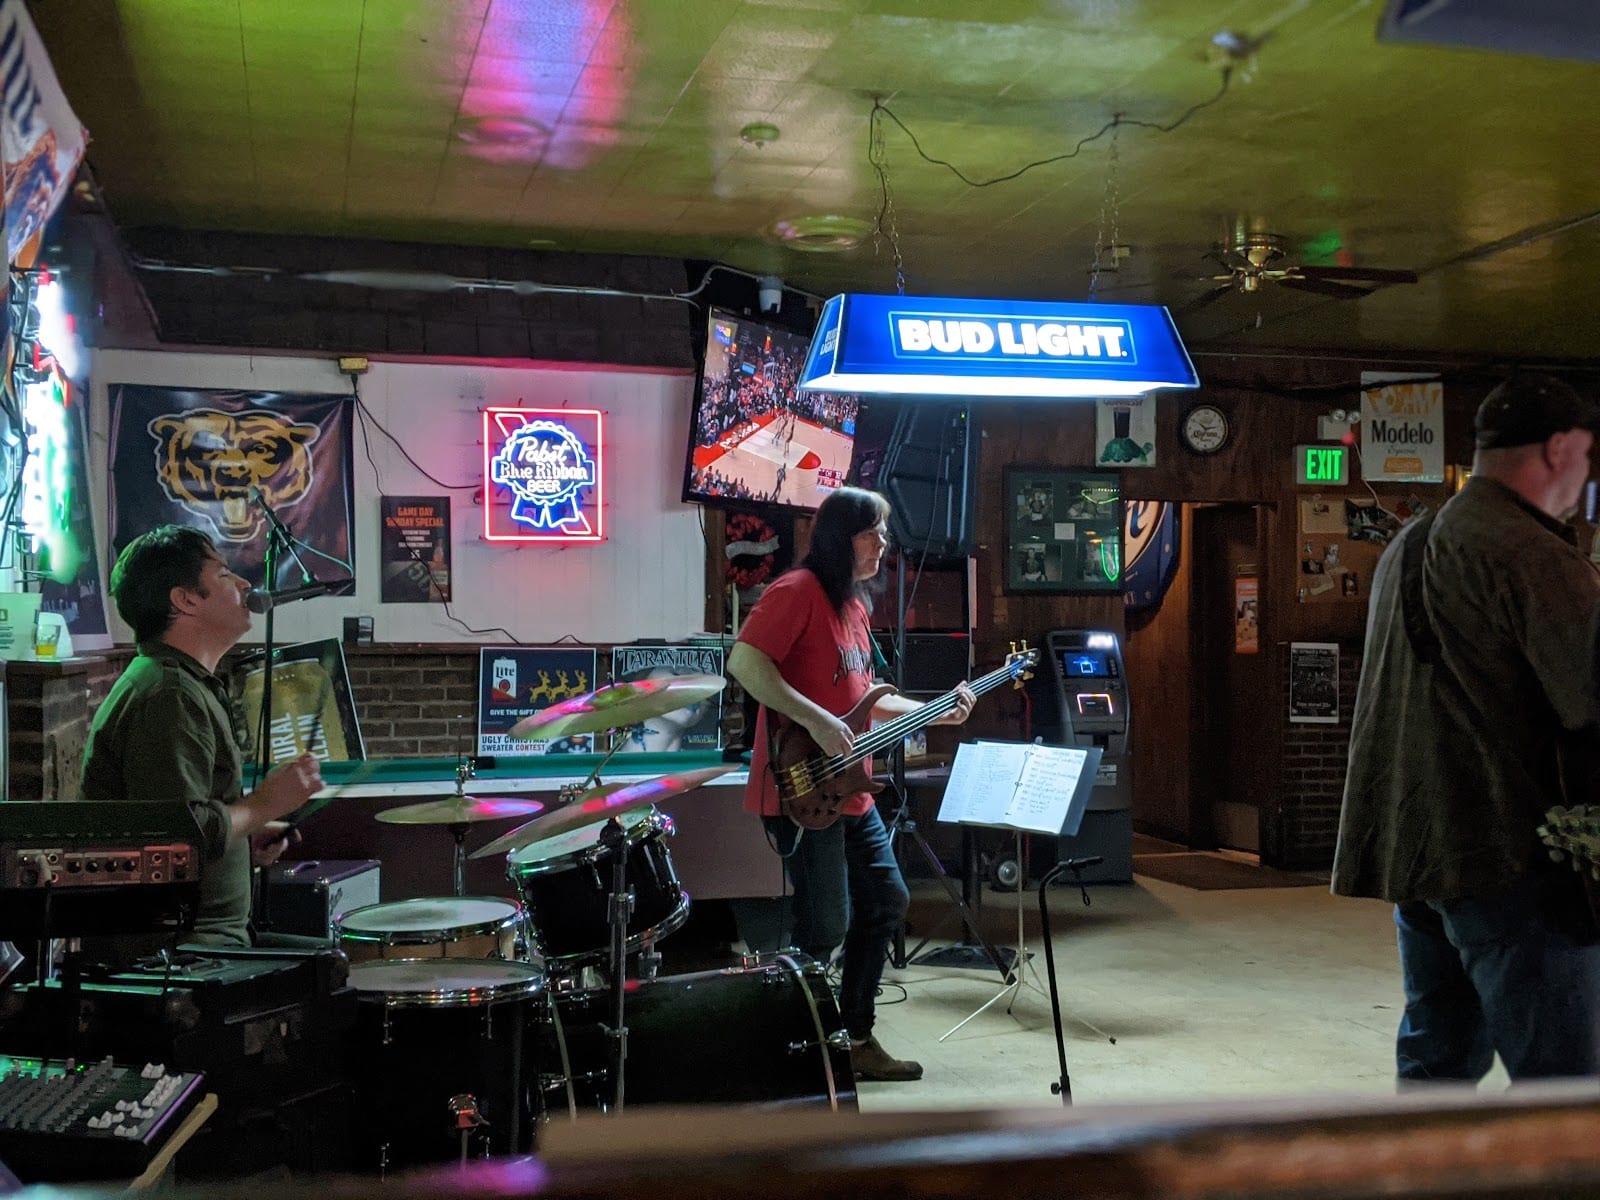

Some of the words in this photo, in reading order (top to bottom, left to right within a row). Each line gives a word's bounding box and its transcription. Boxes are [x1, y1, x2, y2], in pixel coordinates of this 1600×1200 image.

[899, 319, 995, 353] BUD
[1371, 420, 1434, 445] Modelo
[514, 436, 571, 463] Pabst
[500, 461, 533, 479] Blue
[535, 461, 588, 480] Ribbon
[1306, 449, 1342, 480] EXIT
[527, 480, 561, 492] BEER
[397, 507, 419, 517] GAME
[420, 507, 434, 517] DAY
[415, 517, 444, 527] SPECIAL
[496, 666, 515, 679] Lite
[481, 735, 502, 744] UGLY
[515, 744, 546, 752] CONTEST
